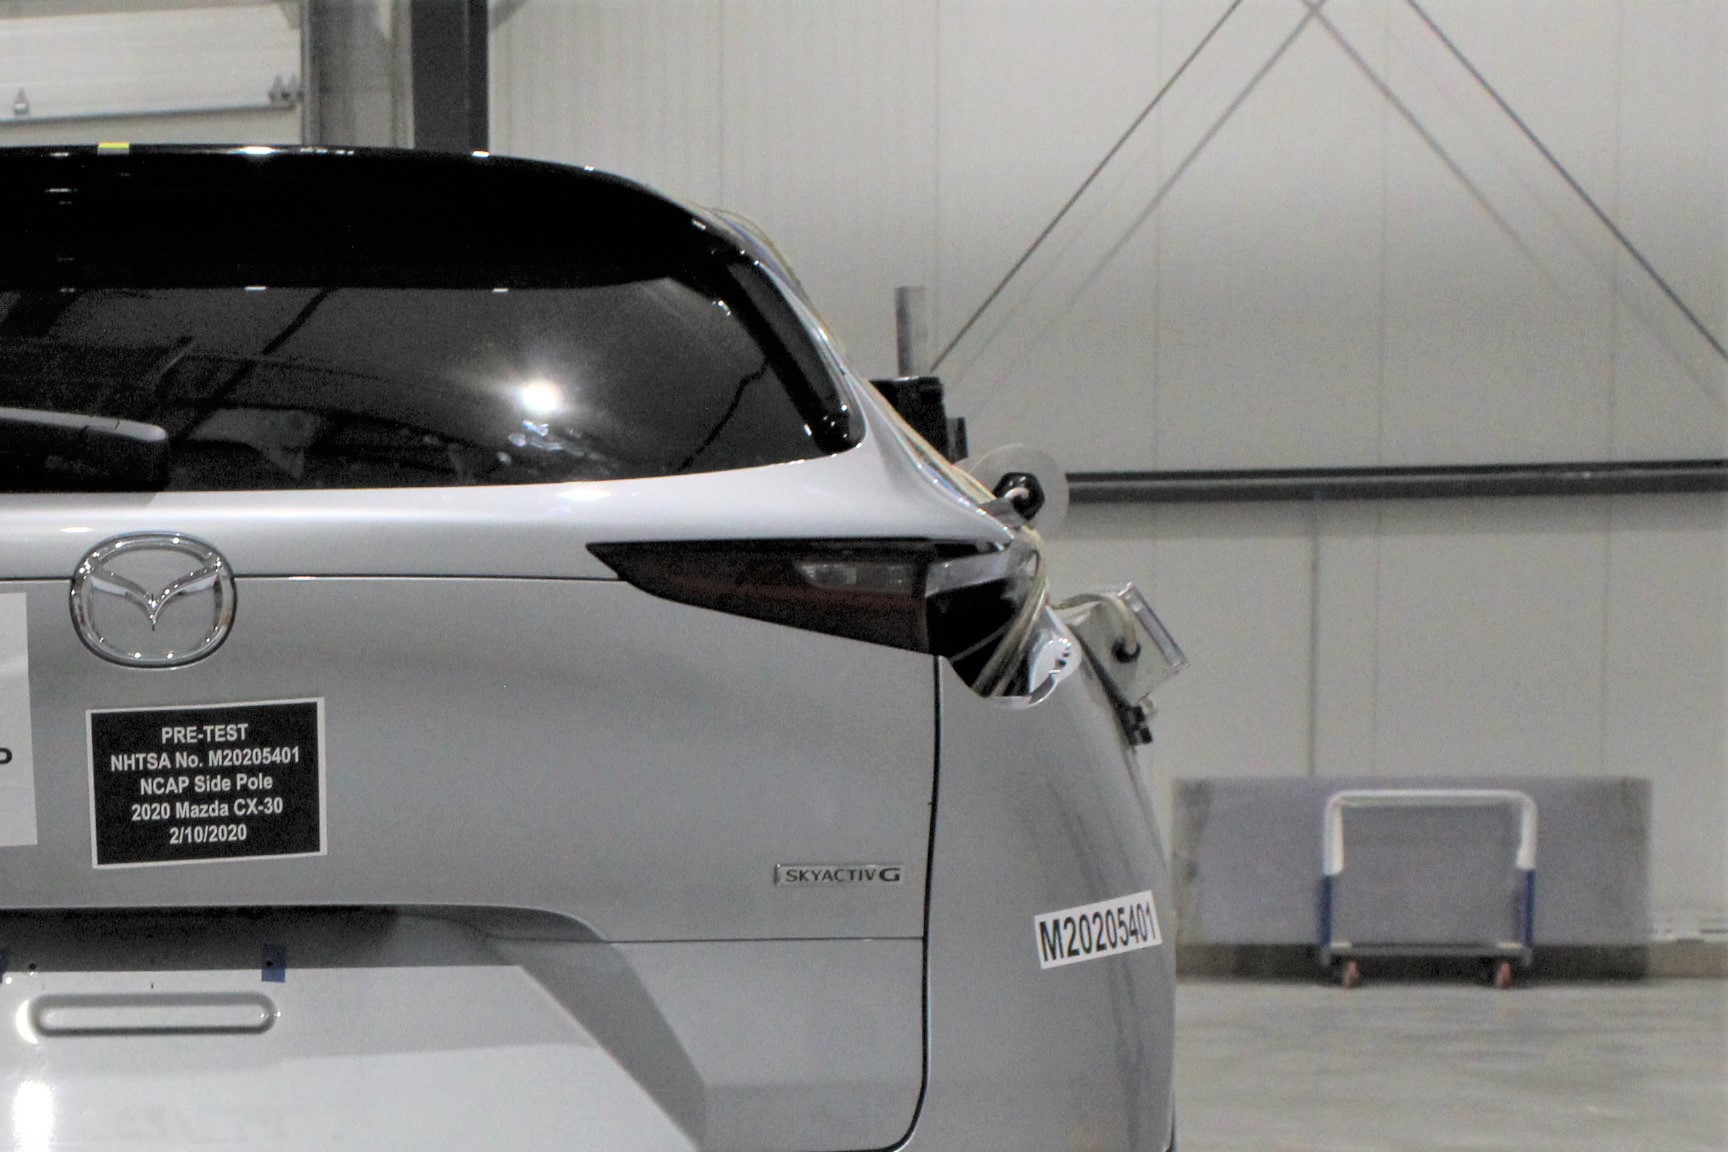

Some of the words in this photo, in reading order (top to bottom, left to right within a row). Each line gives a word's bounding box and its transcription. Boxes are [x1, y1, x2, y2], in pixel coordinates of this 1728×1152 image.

[161, 723, 249, 745] PRE-TEST
[110, 752, 172, 772] NHTSA
[175, 752, 204, 769] No.
[208, 746, 300, 767] M20205401
[140, 776, 190, 796] NCAP
[194, 775, 232, 794] Side
[236, 773, 274, 791] Pole
[131, 802, 171, 822] 2020
[175, 800, 229, 819] Mazda
[233, 797, 284, 816] CX-30
[169, 823, 248, 845] 2/10/2020
[1038, 899, 1158, 963] M20205401
